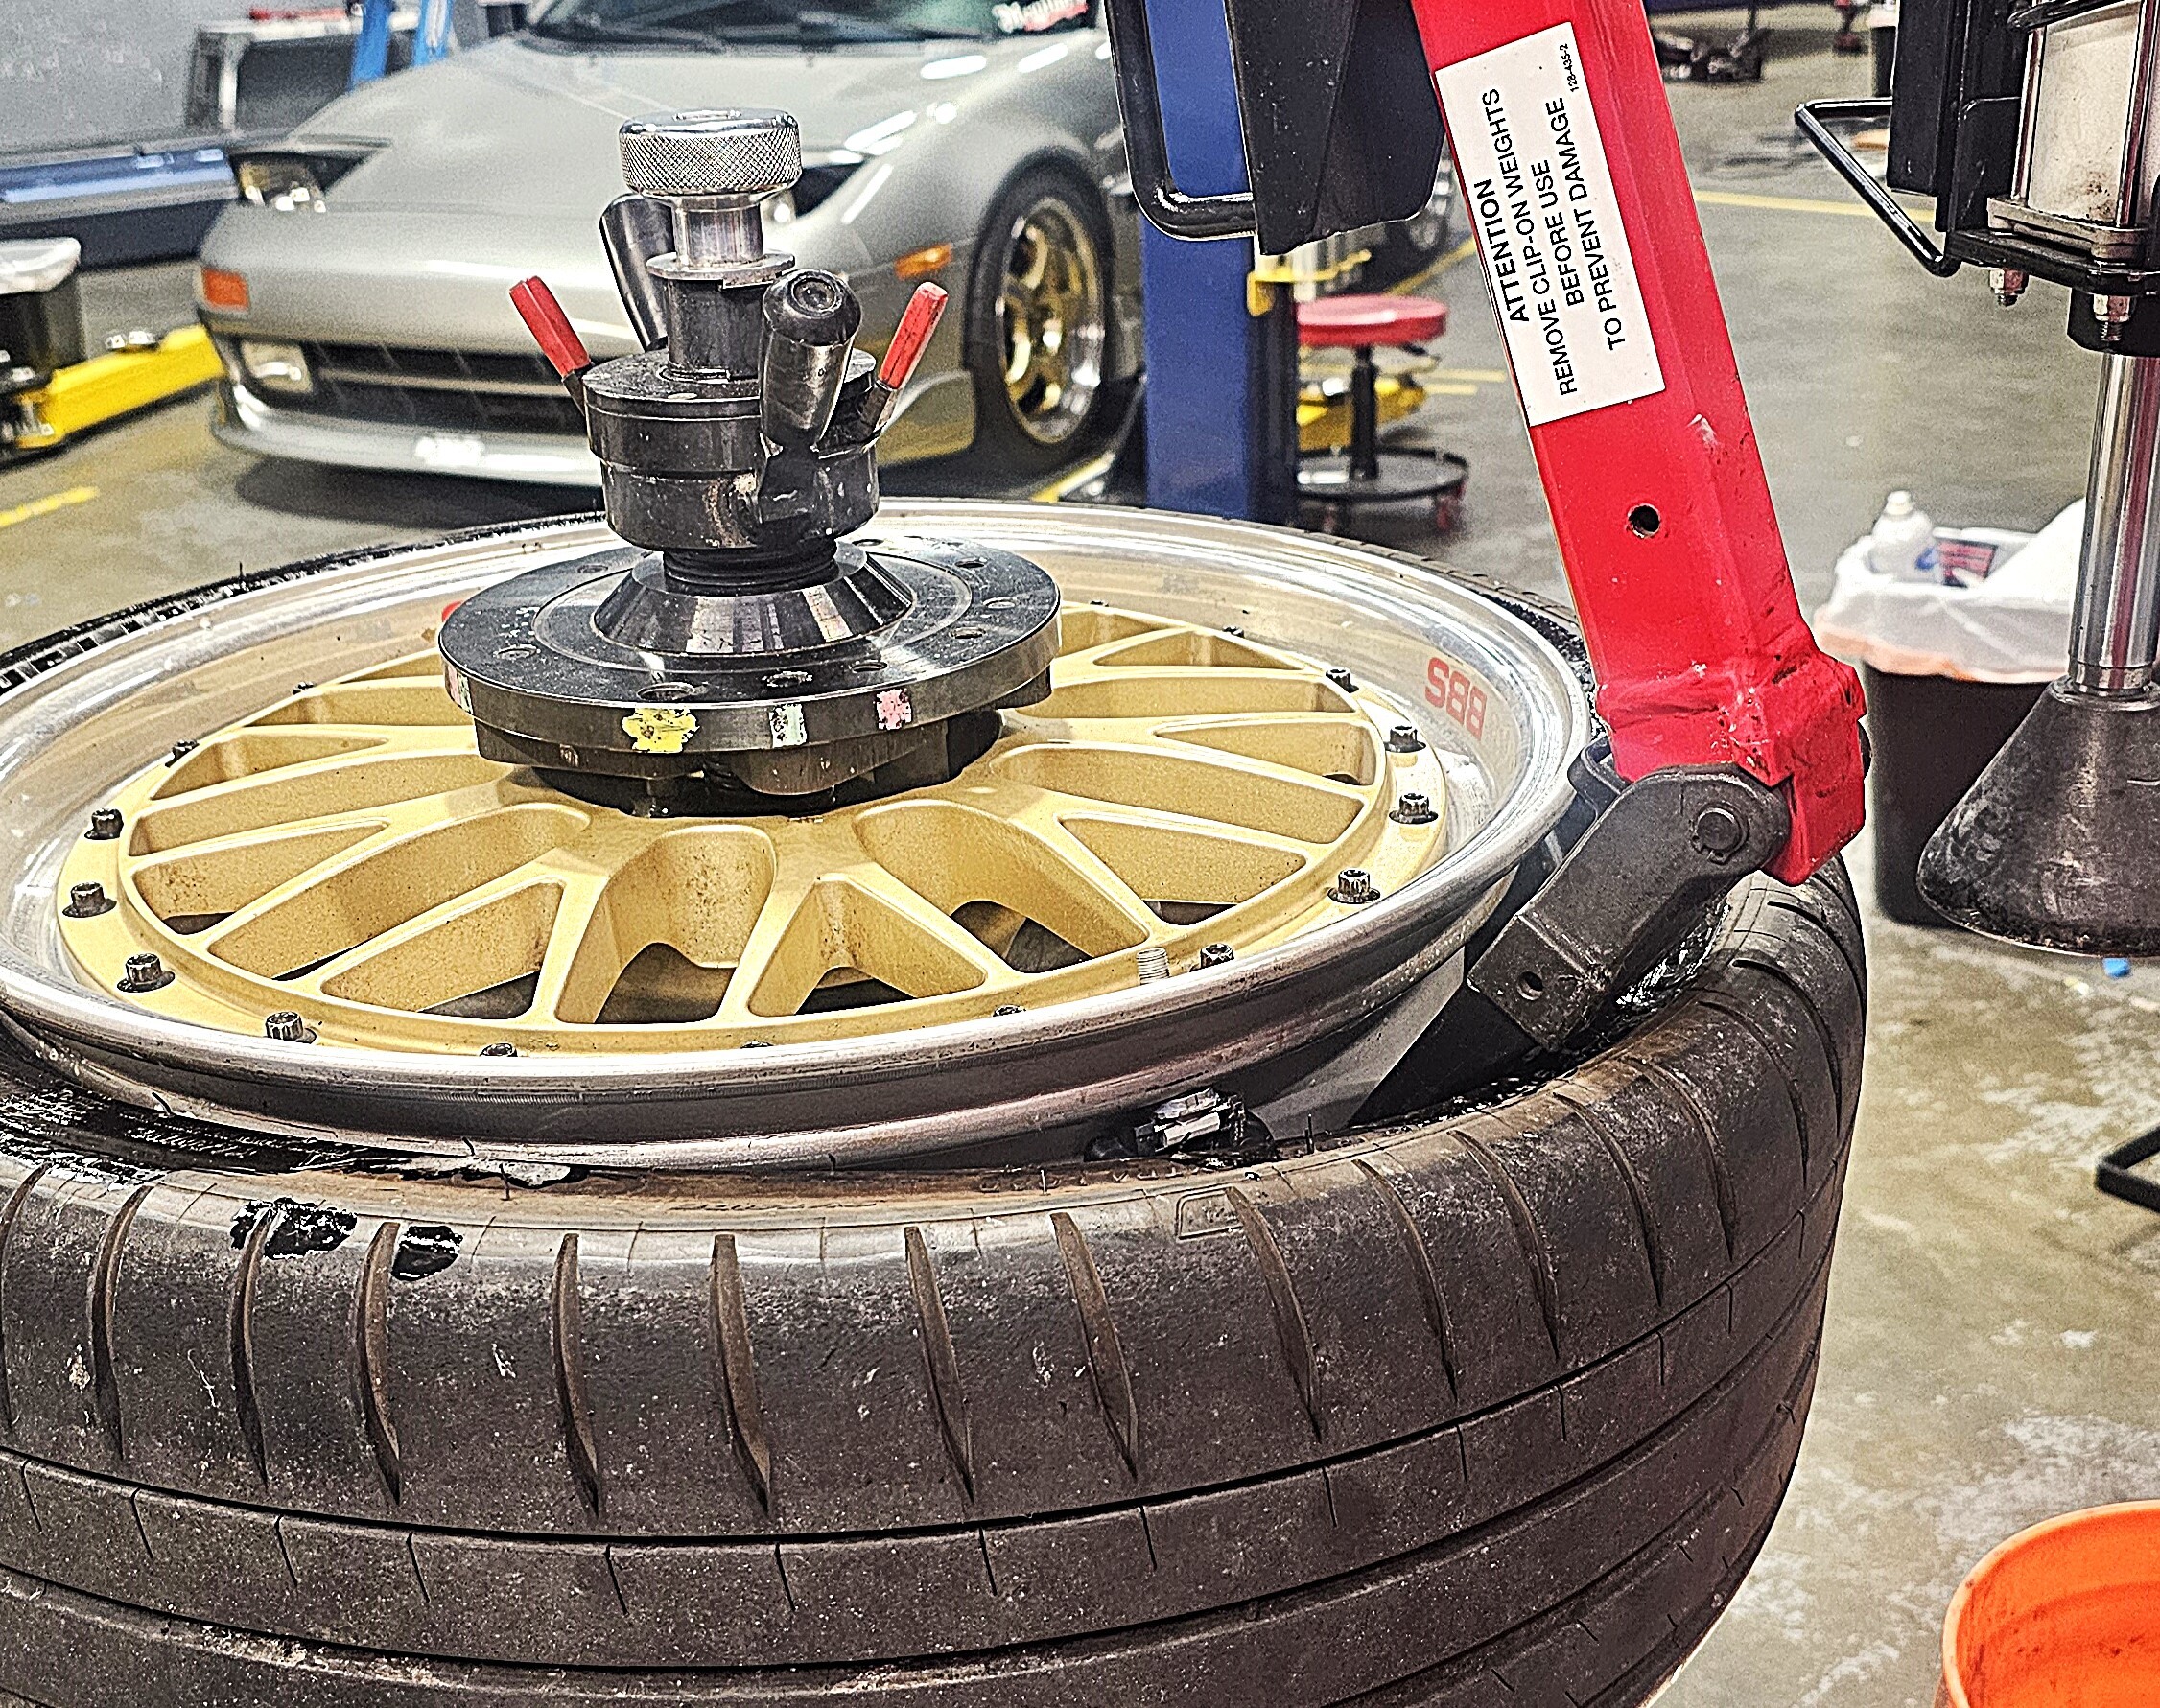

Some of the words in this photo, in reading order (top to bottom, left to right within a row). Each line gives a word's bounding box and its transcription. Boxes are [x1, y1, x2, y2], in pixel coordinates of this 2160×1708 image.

[1559, 43, 1579, 93] 128-435-2
[1482, 89, 1523, 198] WEIGHTS
[1531, 160, 1559, 208] USE
[1546, 98, 1587, 201] DAMAGE
[1474, 179, 1529, 321] ATTENTION
[1511, 200, 1549, 294] CLIP-ON
[1544, 212, 1584, 306] BEFORE
[1574, 209, 1616, 312] PREVENT
[1538, 299, 1578, 395] REMOVE
[1604, 317, 1625, 350] TO
[1425, 657, 1487, 741] BBS
